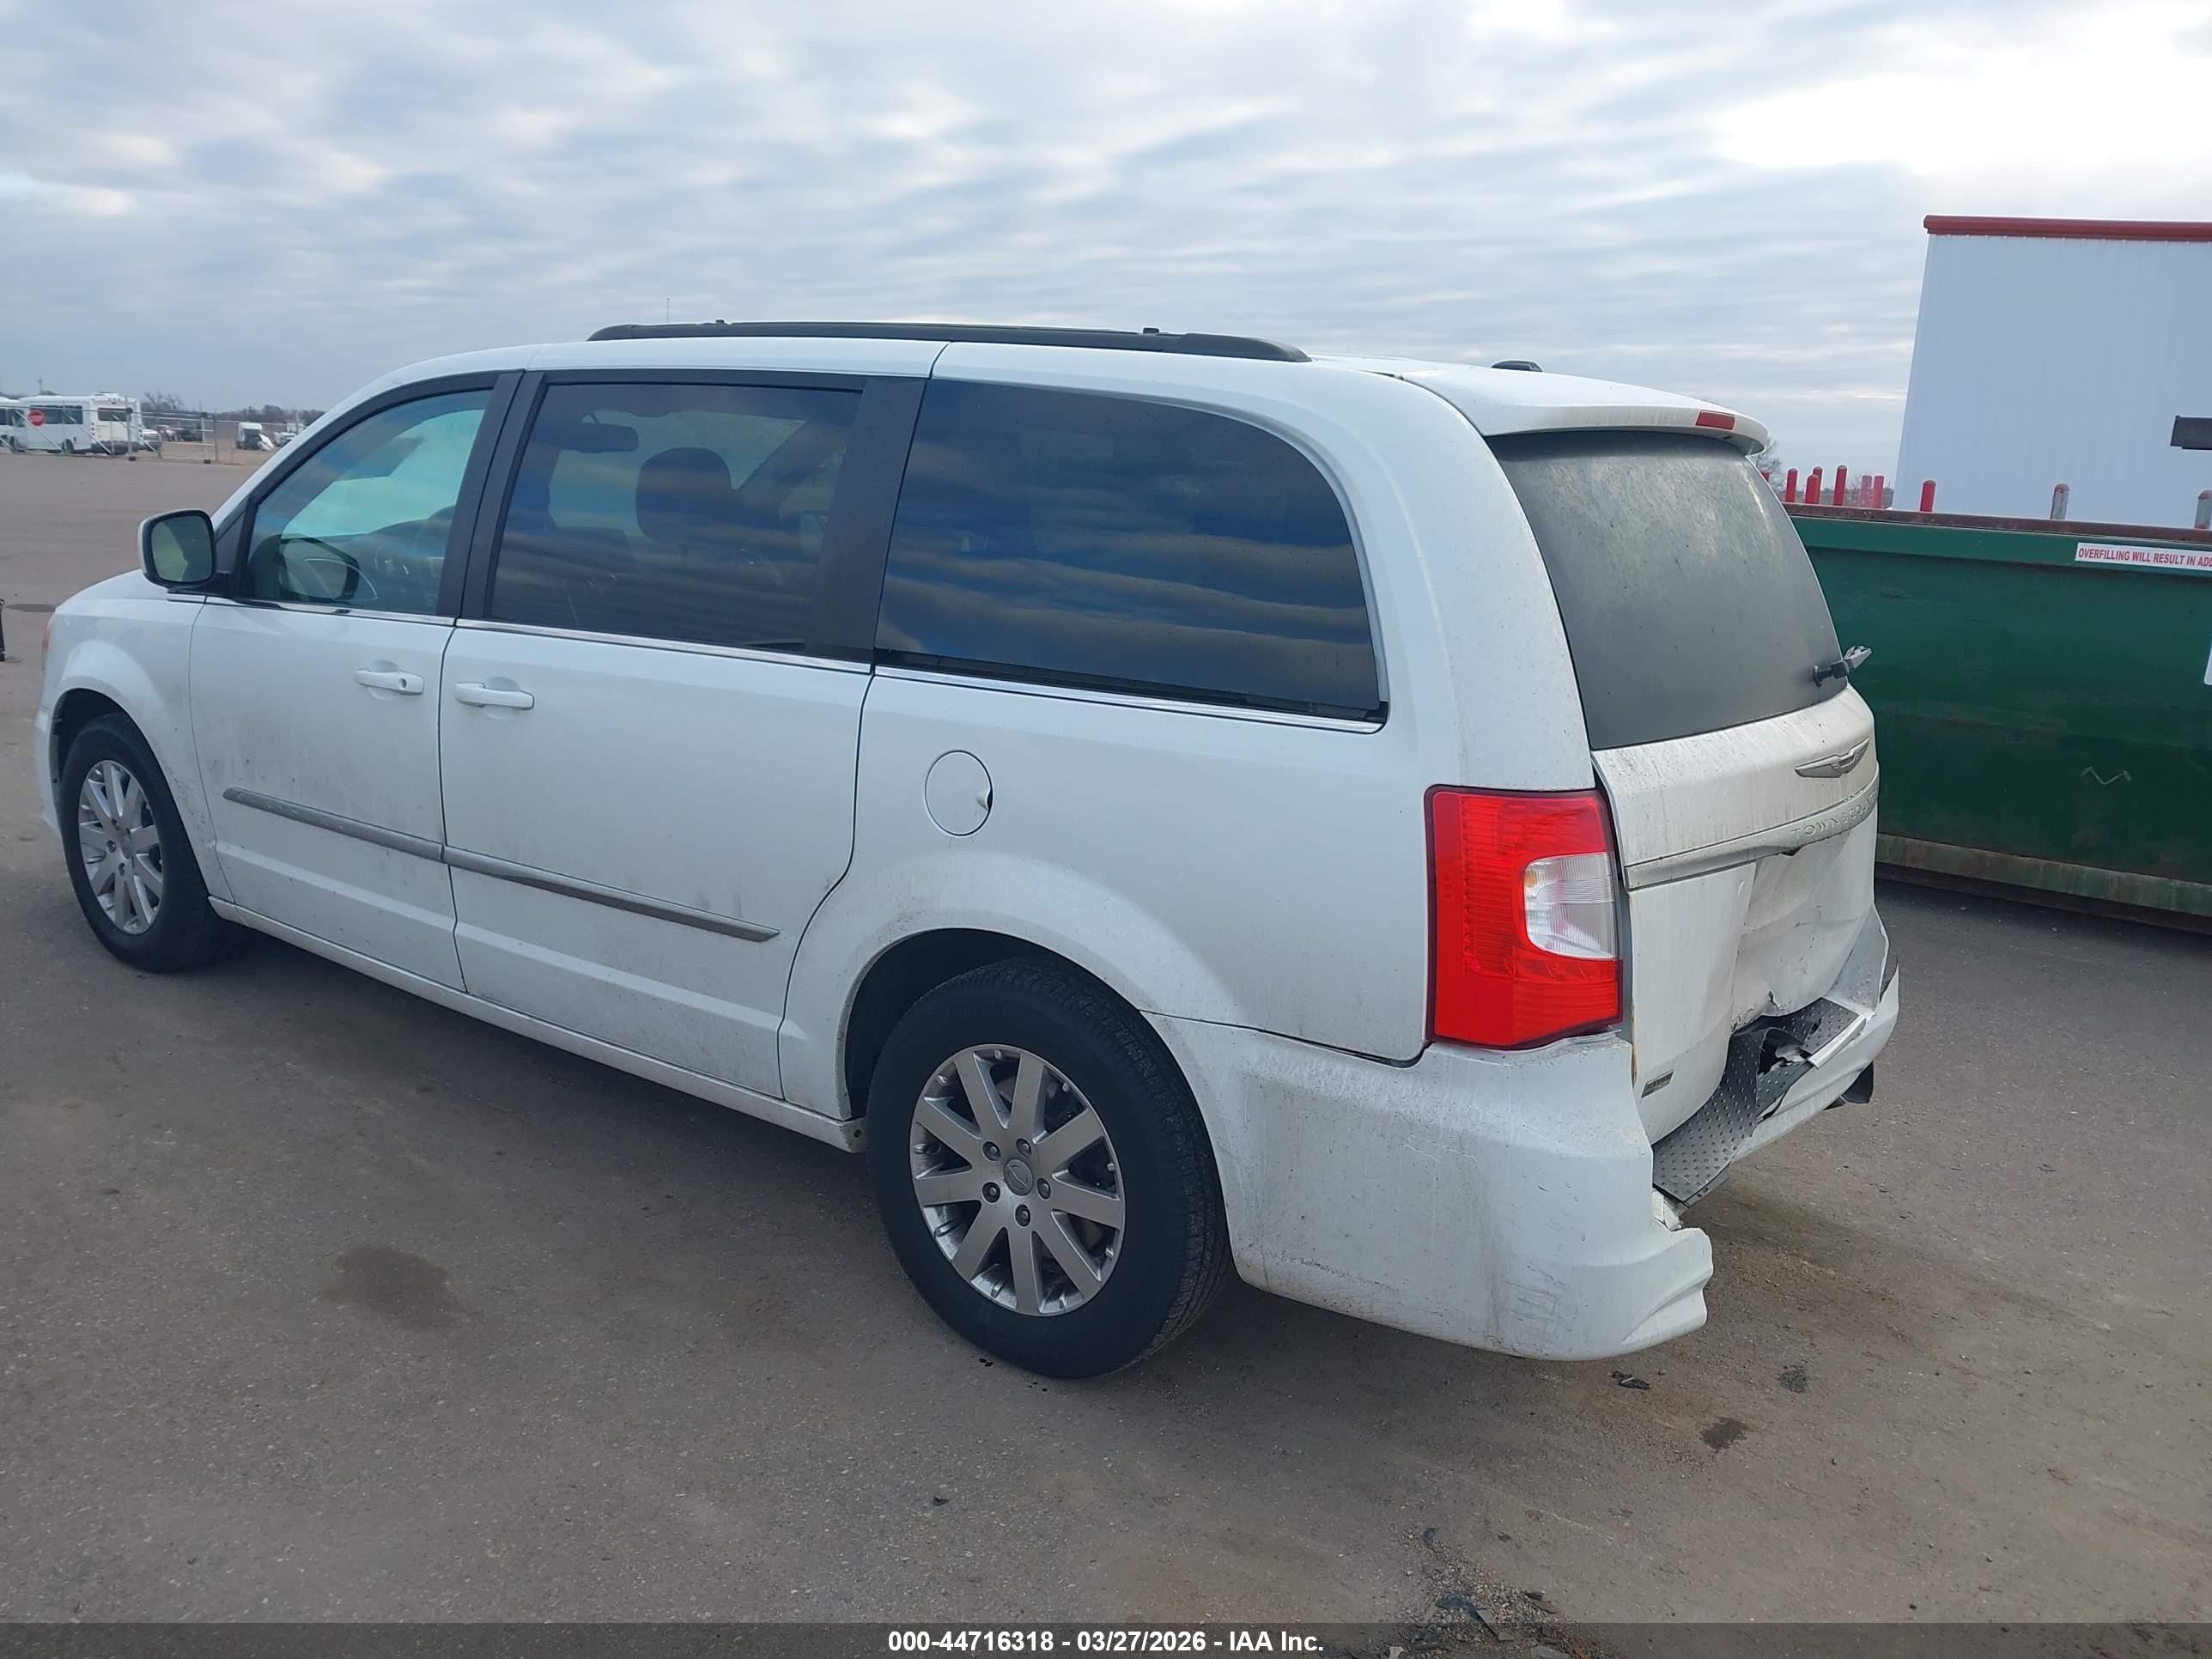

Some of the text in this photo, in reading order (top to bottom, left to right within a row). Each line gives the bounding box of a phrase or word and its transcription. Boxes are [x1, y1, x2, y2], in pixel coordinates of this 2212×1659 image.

[2078, 548, 2130, 561] OVERFILLING
[2132, 551, 2151, 562] WILL
[2153, 552, 2185, 565] RESULT
[2186, 555, 2197, 566] IN
[1790, 817, 1839, 839] TOWN
